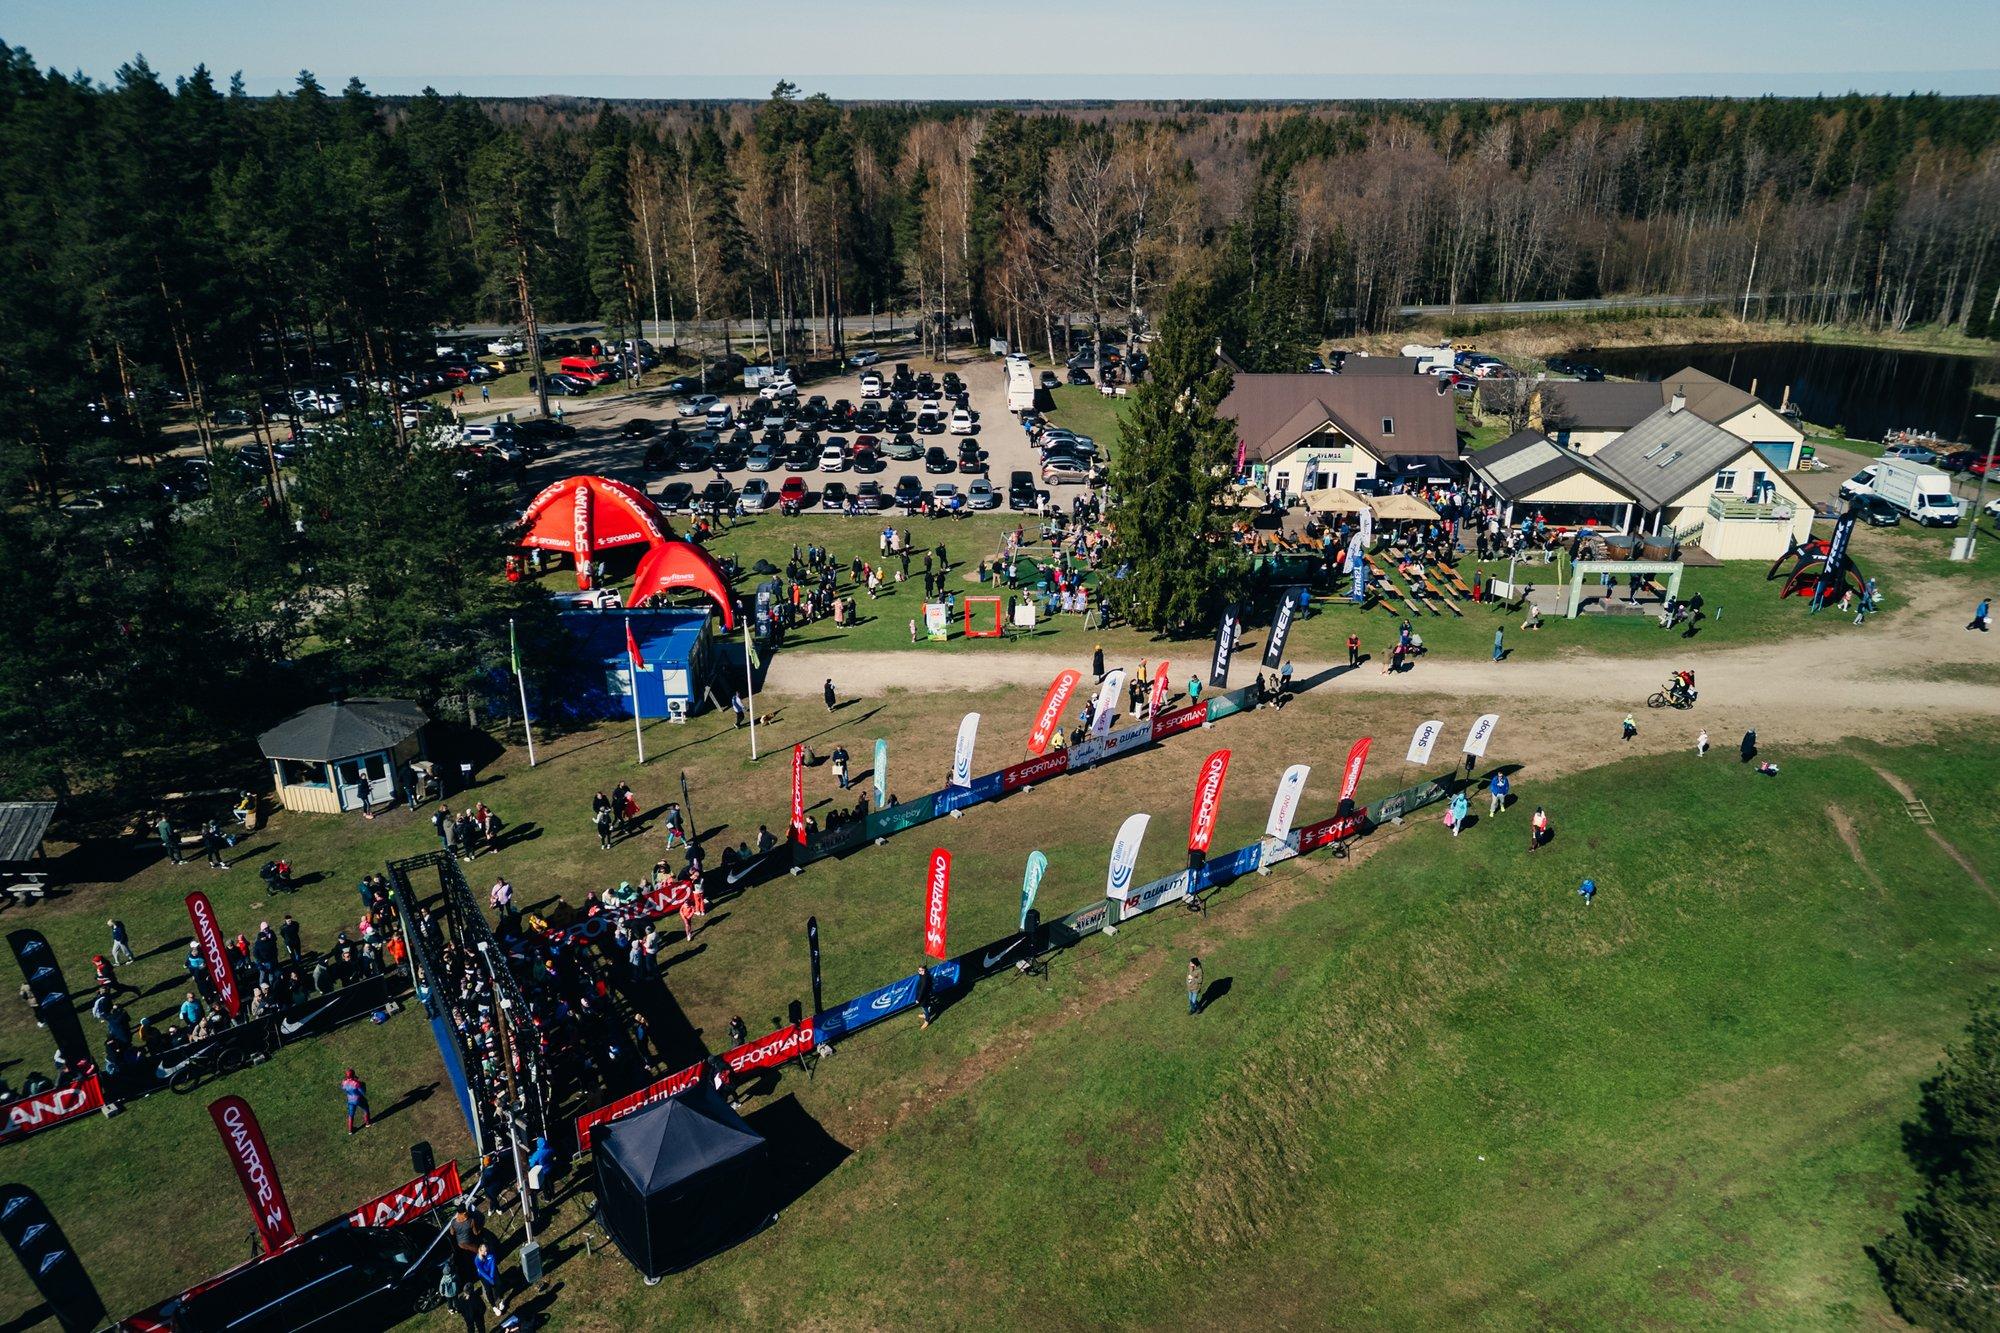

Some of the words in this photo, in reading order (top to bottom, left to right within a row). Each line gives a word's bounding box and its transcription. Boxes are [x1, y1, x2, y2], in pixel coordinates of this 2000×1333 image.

[575, 486, 588, 552] SPORTLAND
[538, 537, 571, 547] SPORTLAND
[607, 532, 641, 544] SPORTLAND
[1269, 595, 1295, 658] TREK
[1214, 613, 1234, 678] TREK
[1040, 674, 1073, 731] SPORTLAND
[1166, 708, 1207, 728] SPORTLAND
[1120, 725, 1151, 744] QUALITY
[1021, 756, 1067, 778] SPORTLAND
[1198, 758, 1223, 827] SPORTLAND
[1318, 815, 1365, 838] SPORLAND
[1113, 840, 1125, 862] Tallinn
[929, 855, 946, 929] SPORTLAND
[1144, 877, 1186, 900] QUALITY
[730, 1028, 813, 1072] SPORTLAND
